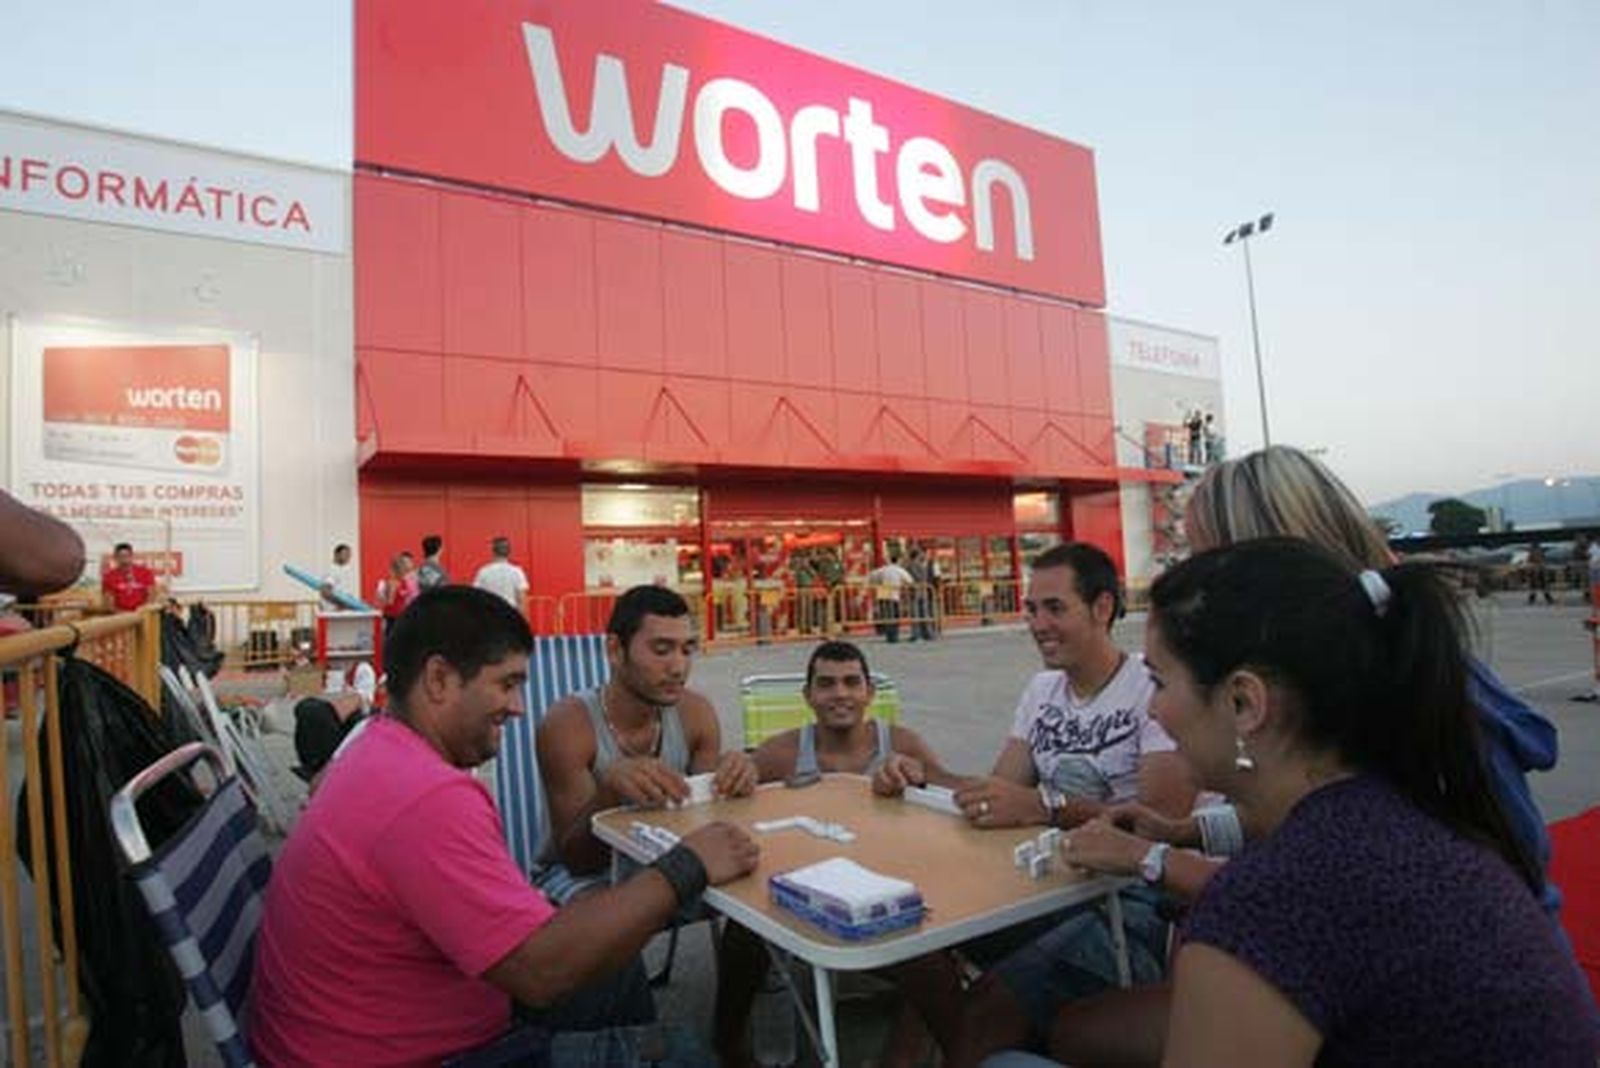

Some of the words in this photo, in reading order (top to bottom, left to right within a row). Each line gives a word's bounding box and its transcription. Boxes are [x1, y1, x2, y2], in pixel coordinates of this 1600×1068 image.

[522, 21, 1034, 261] worten
[127, 387, 222, 410] worten
[30, 482, 100, 500] TODAS
[107, 483, 146, 500] TUS
[153, 484, 244, 502] COMPRAS
